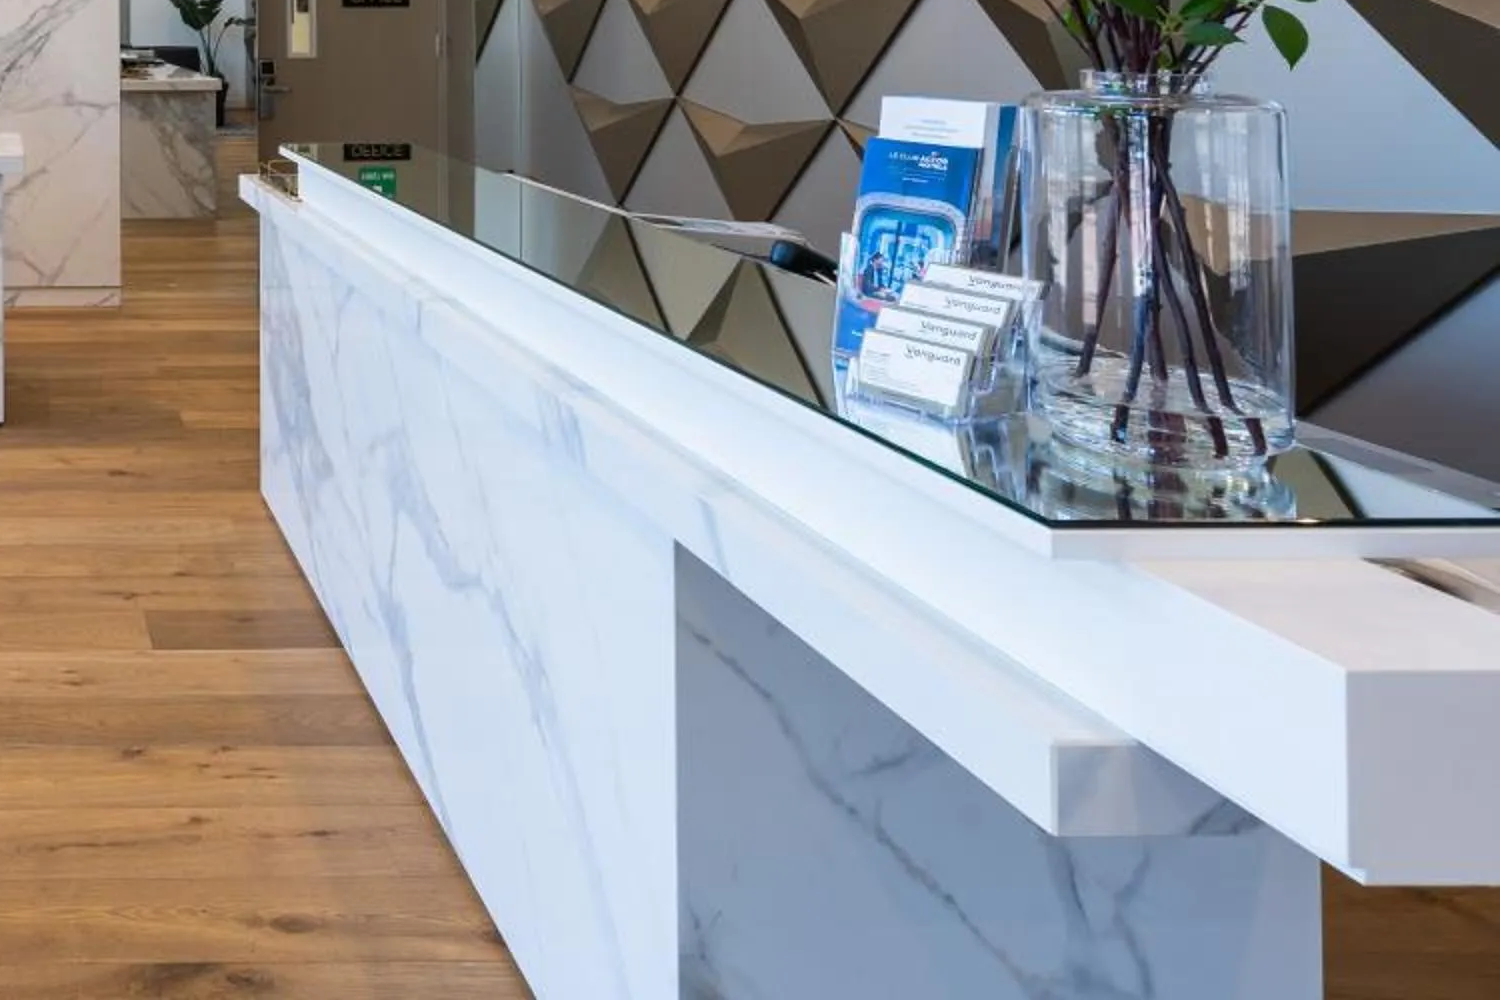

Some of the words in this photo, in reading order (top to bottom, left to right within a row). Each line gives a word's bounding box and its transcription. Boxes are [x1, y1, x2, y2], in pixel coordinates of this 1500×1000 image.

[943, 296, 1001, 316] Vanguard
[919, 320, 978, 341] Vanguard
[904, 343, 962, 366] Vanguard
